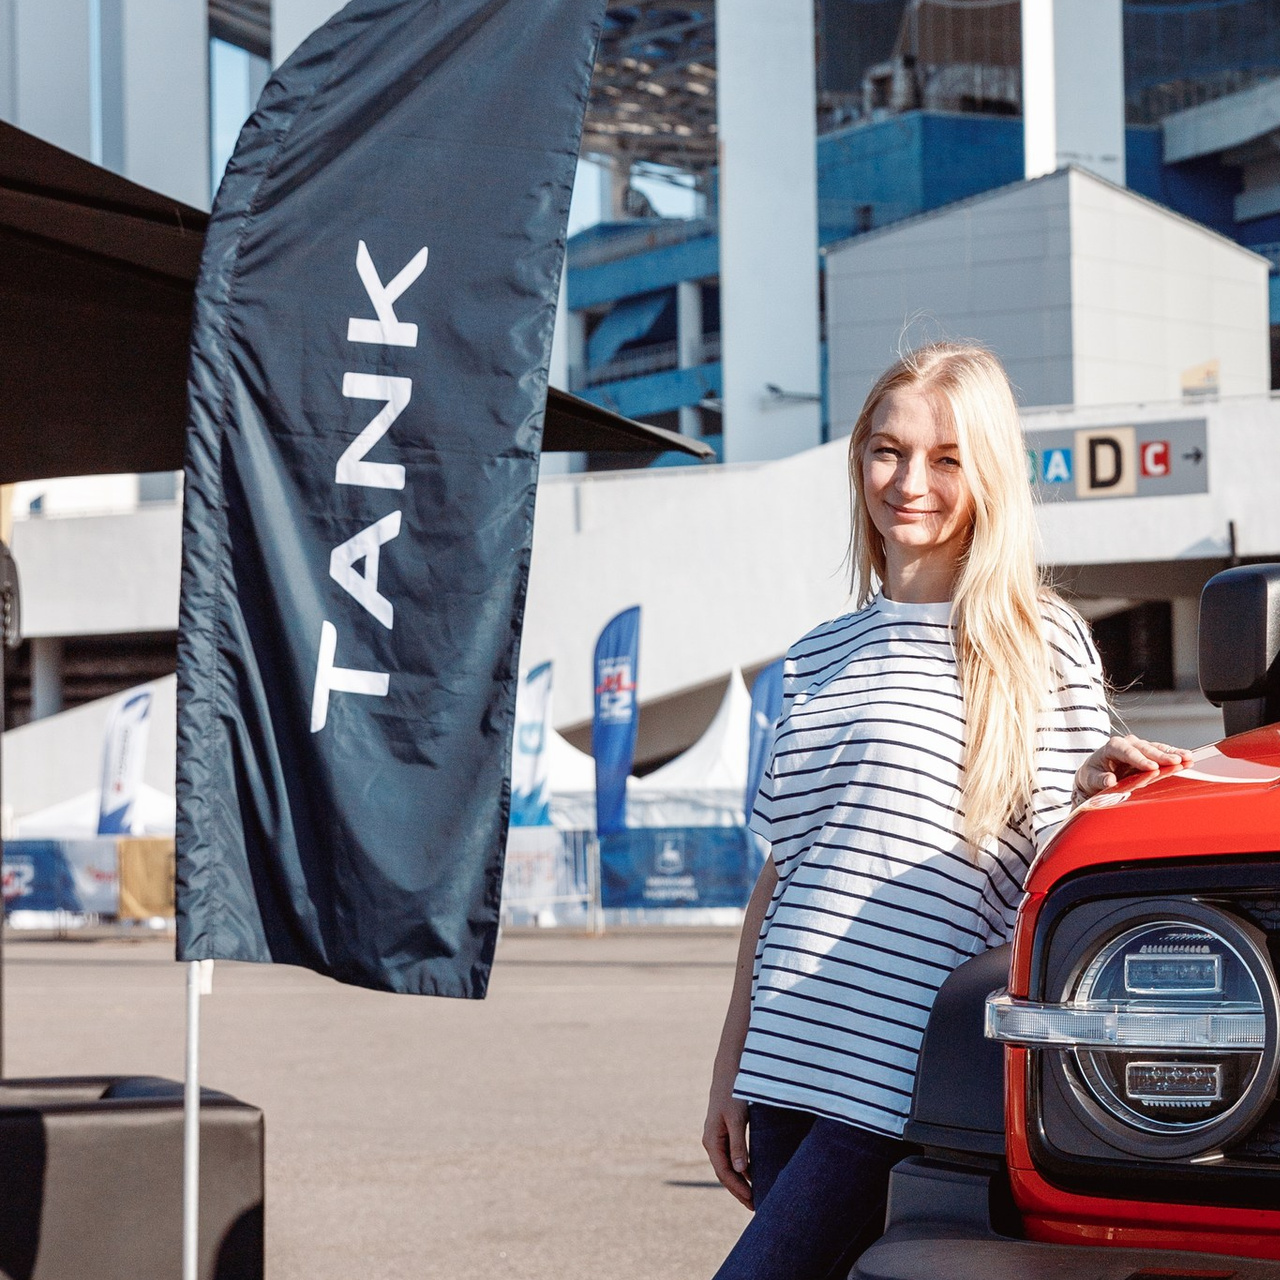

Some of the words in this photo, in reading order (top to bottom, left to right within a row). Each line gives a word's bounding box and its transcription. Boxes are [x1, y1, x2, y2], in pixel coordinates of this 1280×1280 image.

[310, 238, 430, 734] TANK
[1046, 450, 1071, 480] A
[1088, 436, 1123, 489] D
[1143, 442, 1167, 475] C
